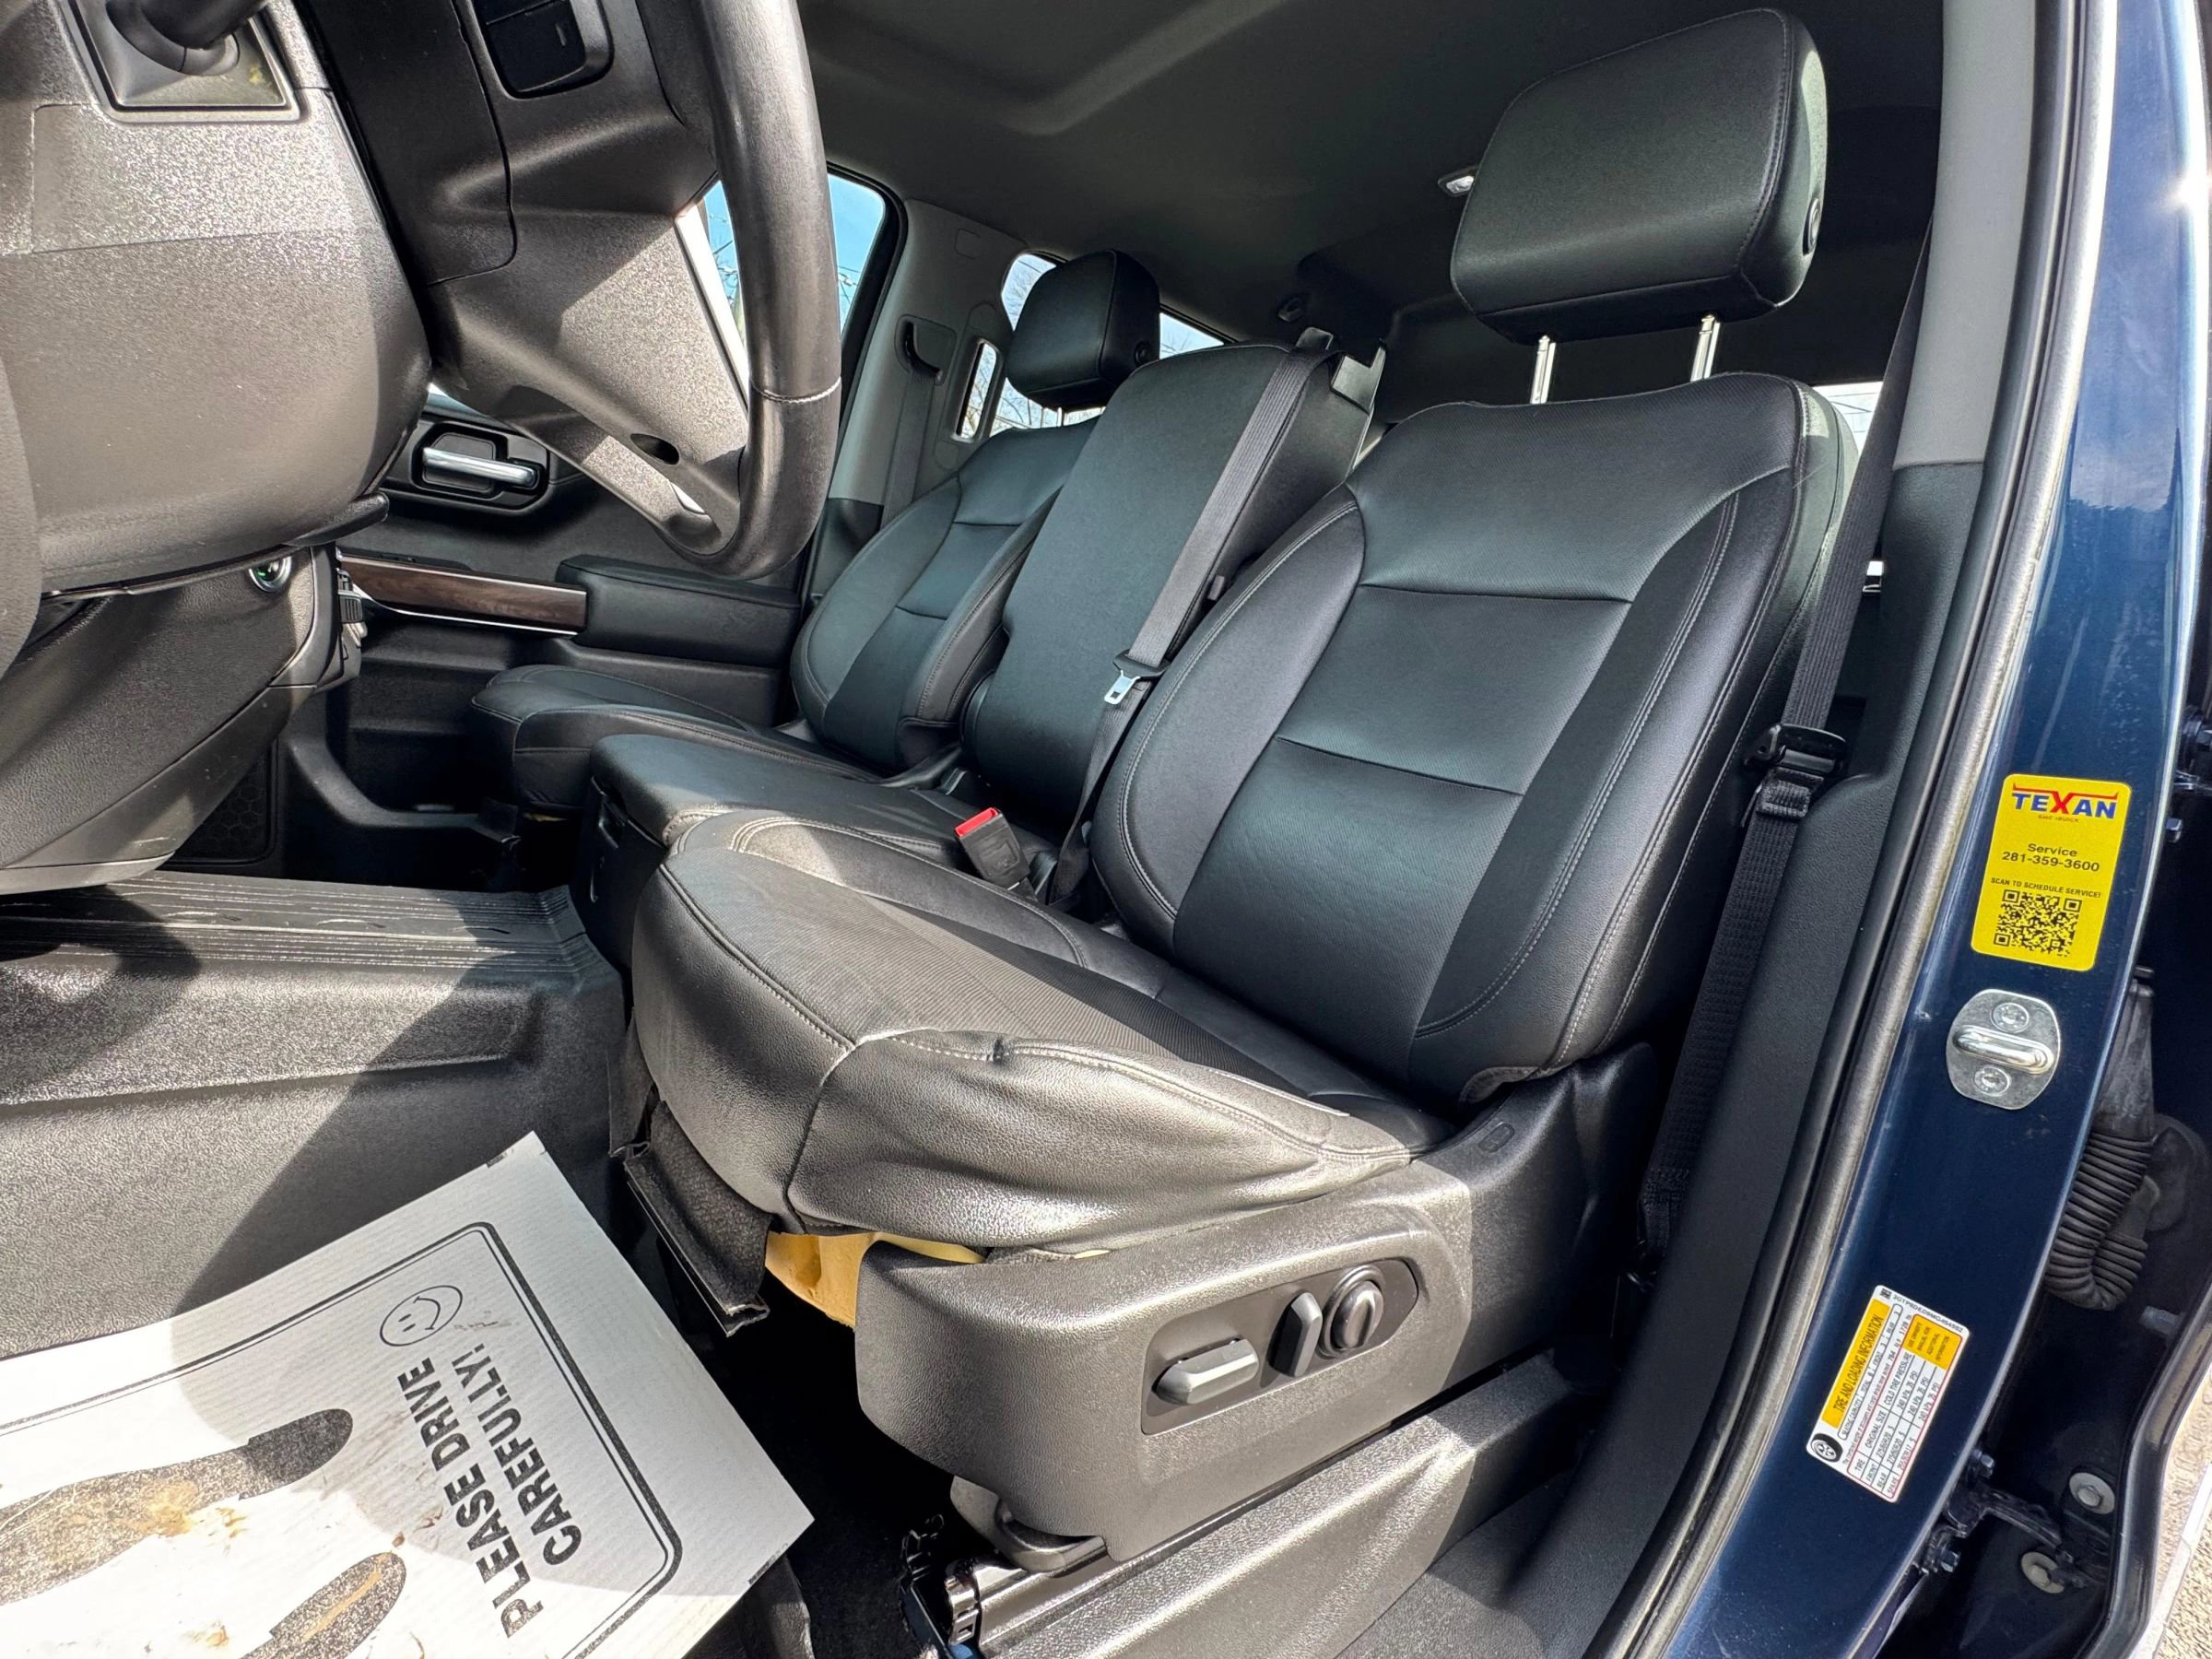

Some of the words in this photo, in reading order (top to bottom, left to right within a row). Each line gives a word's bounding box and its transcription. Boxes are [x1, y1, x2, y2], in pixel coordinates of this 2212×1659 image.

[2012, 788, 2117, 819] TEXAN
[2002, 851, 2100, 872] 281-359-3600
[2028, 843, 2078, 857] Service
[1991, 877, 2010, 886] SCAN
[2024, 882, 2064, 893] SCHEDULE
[2065, 888, 2101, 898] SERVICE!
[1857, 1313, 1884, 1358] INFORMATION
[1845, 1354, 1866, 1386] LOADING
[1894, 1351, 1912, 1380] PRESSURE
[1839, 1381, 1854, 1398] AND
[1889, 1378, 1900, 1391] TIRE
[1833, 1395, 1848, 1413] TIRE
[1883, 1389, 1896, 1406] COLD
[397, 1357, 471, 1471] DRIVE
[1864, 1422, 1881, 1449] ORIGINAL
[1875, 1409, 1887, 1424] SIZE
[452, 1343, 582, 1565] CAREFULLY!
[1854, 1458, 1866, 1473] TIRE
[444, 1463, 544, 1638] PLEASE
